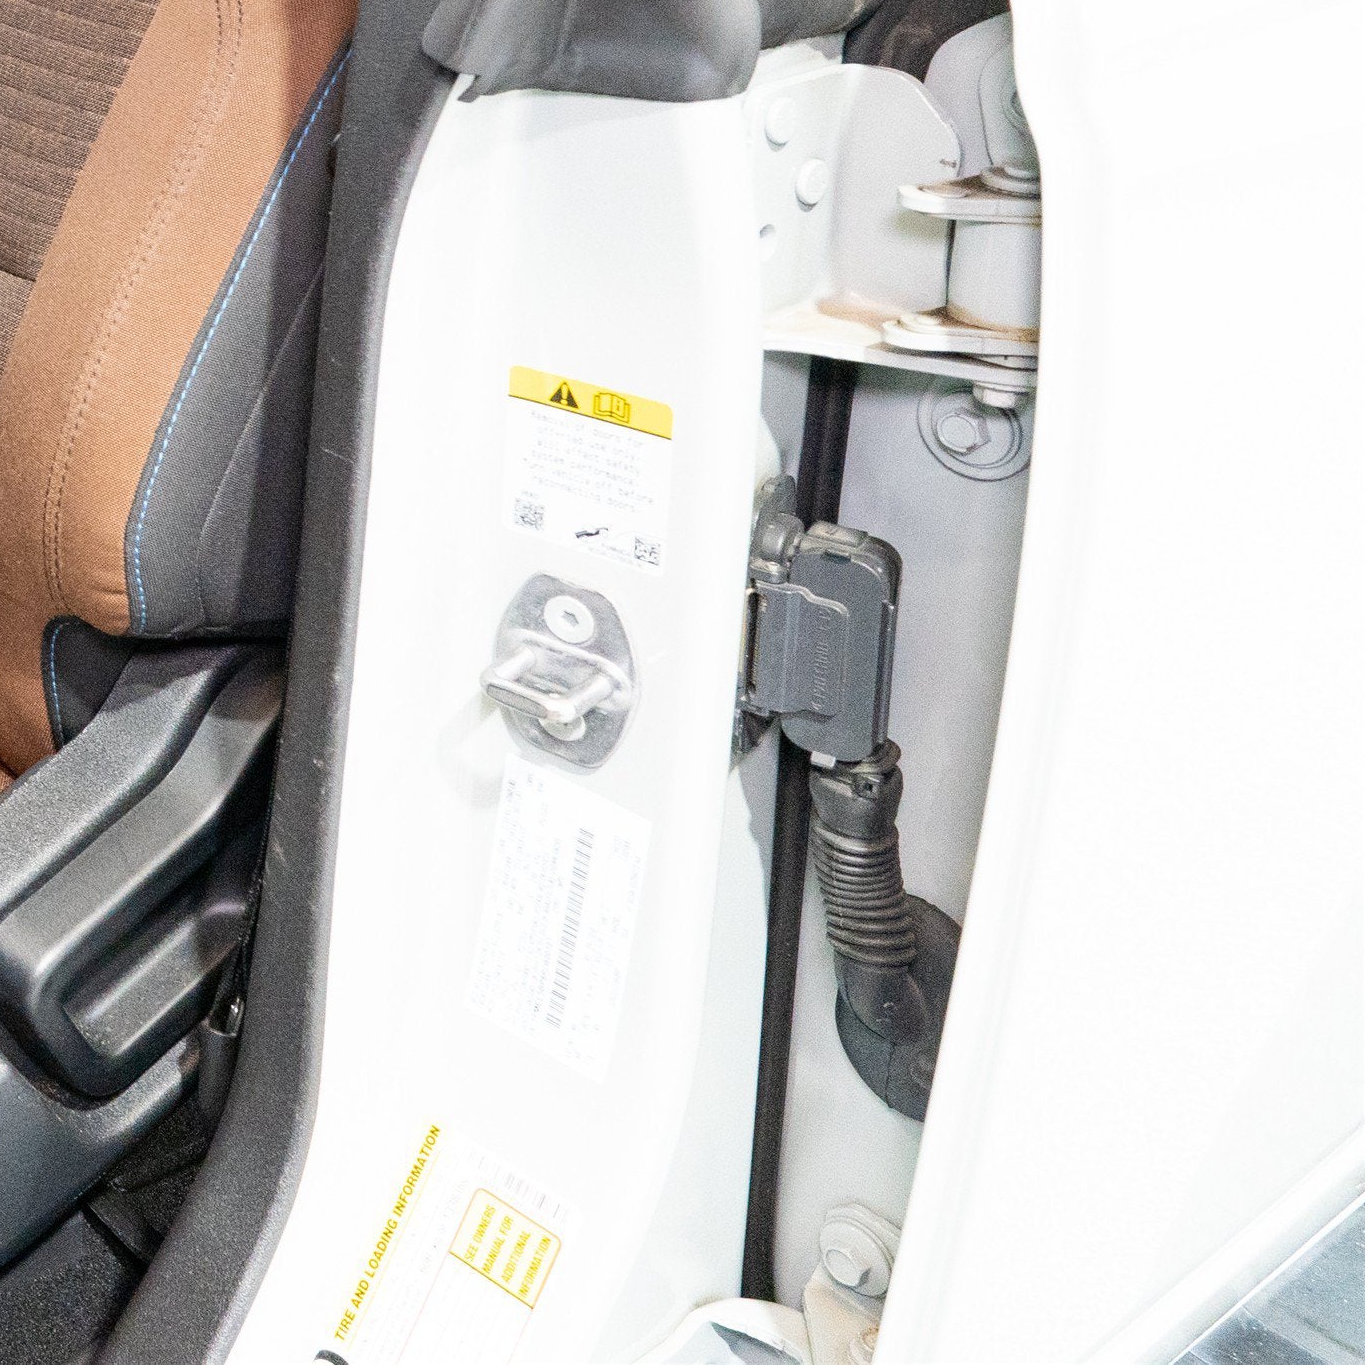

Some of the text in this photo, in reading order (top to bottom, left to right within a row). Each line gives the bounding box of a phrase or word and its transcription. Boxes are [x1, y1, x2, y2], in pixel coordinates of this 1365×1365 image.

[334, 1124, 441, 1342] TIRE AND LOADING INFORMATION
[464, 1204, 496, 1262] SEE OWNERS
[482, 1215, 514, 1275] MANUAL FOR
[501, 1231, 532, 1284] ADDITIONAL
[518, 1235, 552, 1298] INFORMATION
